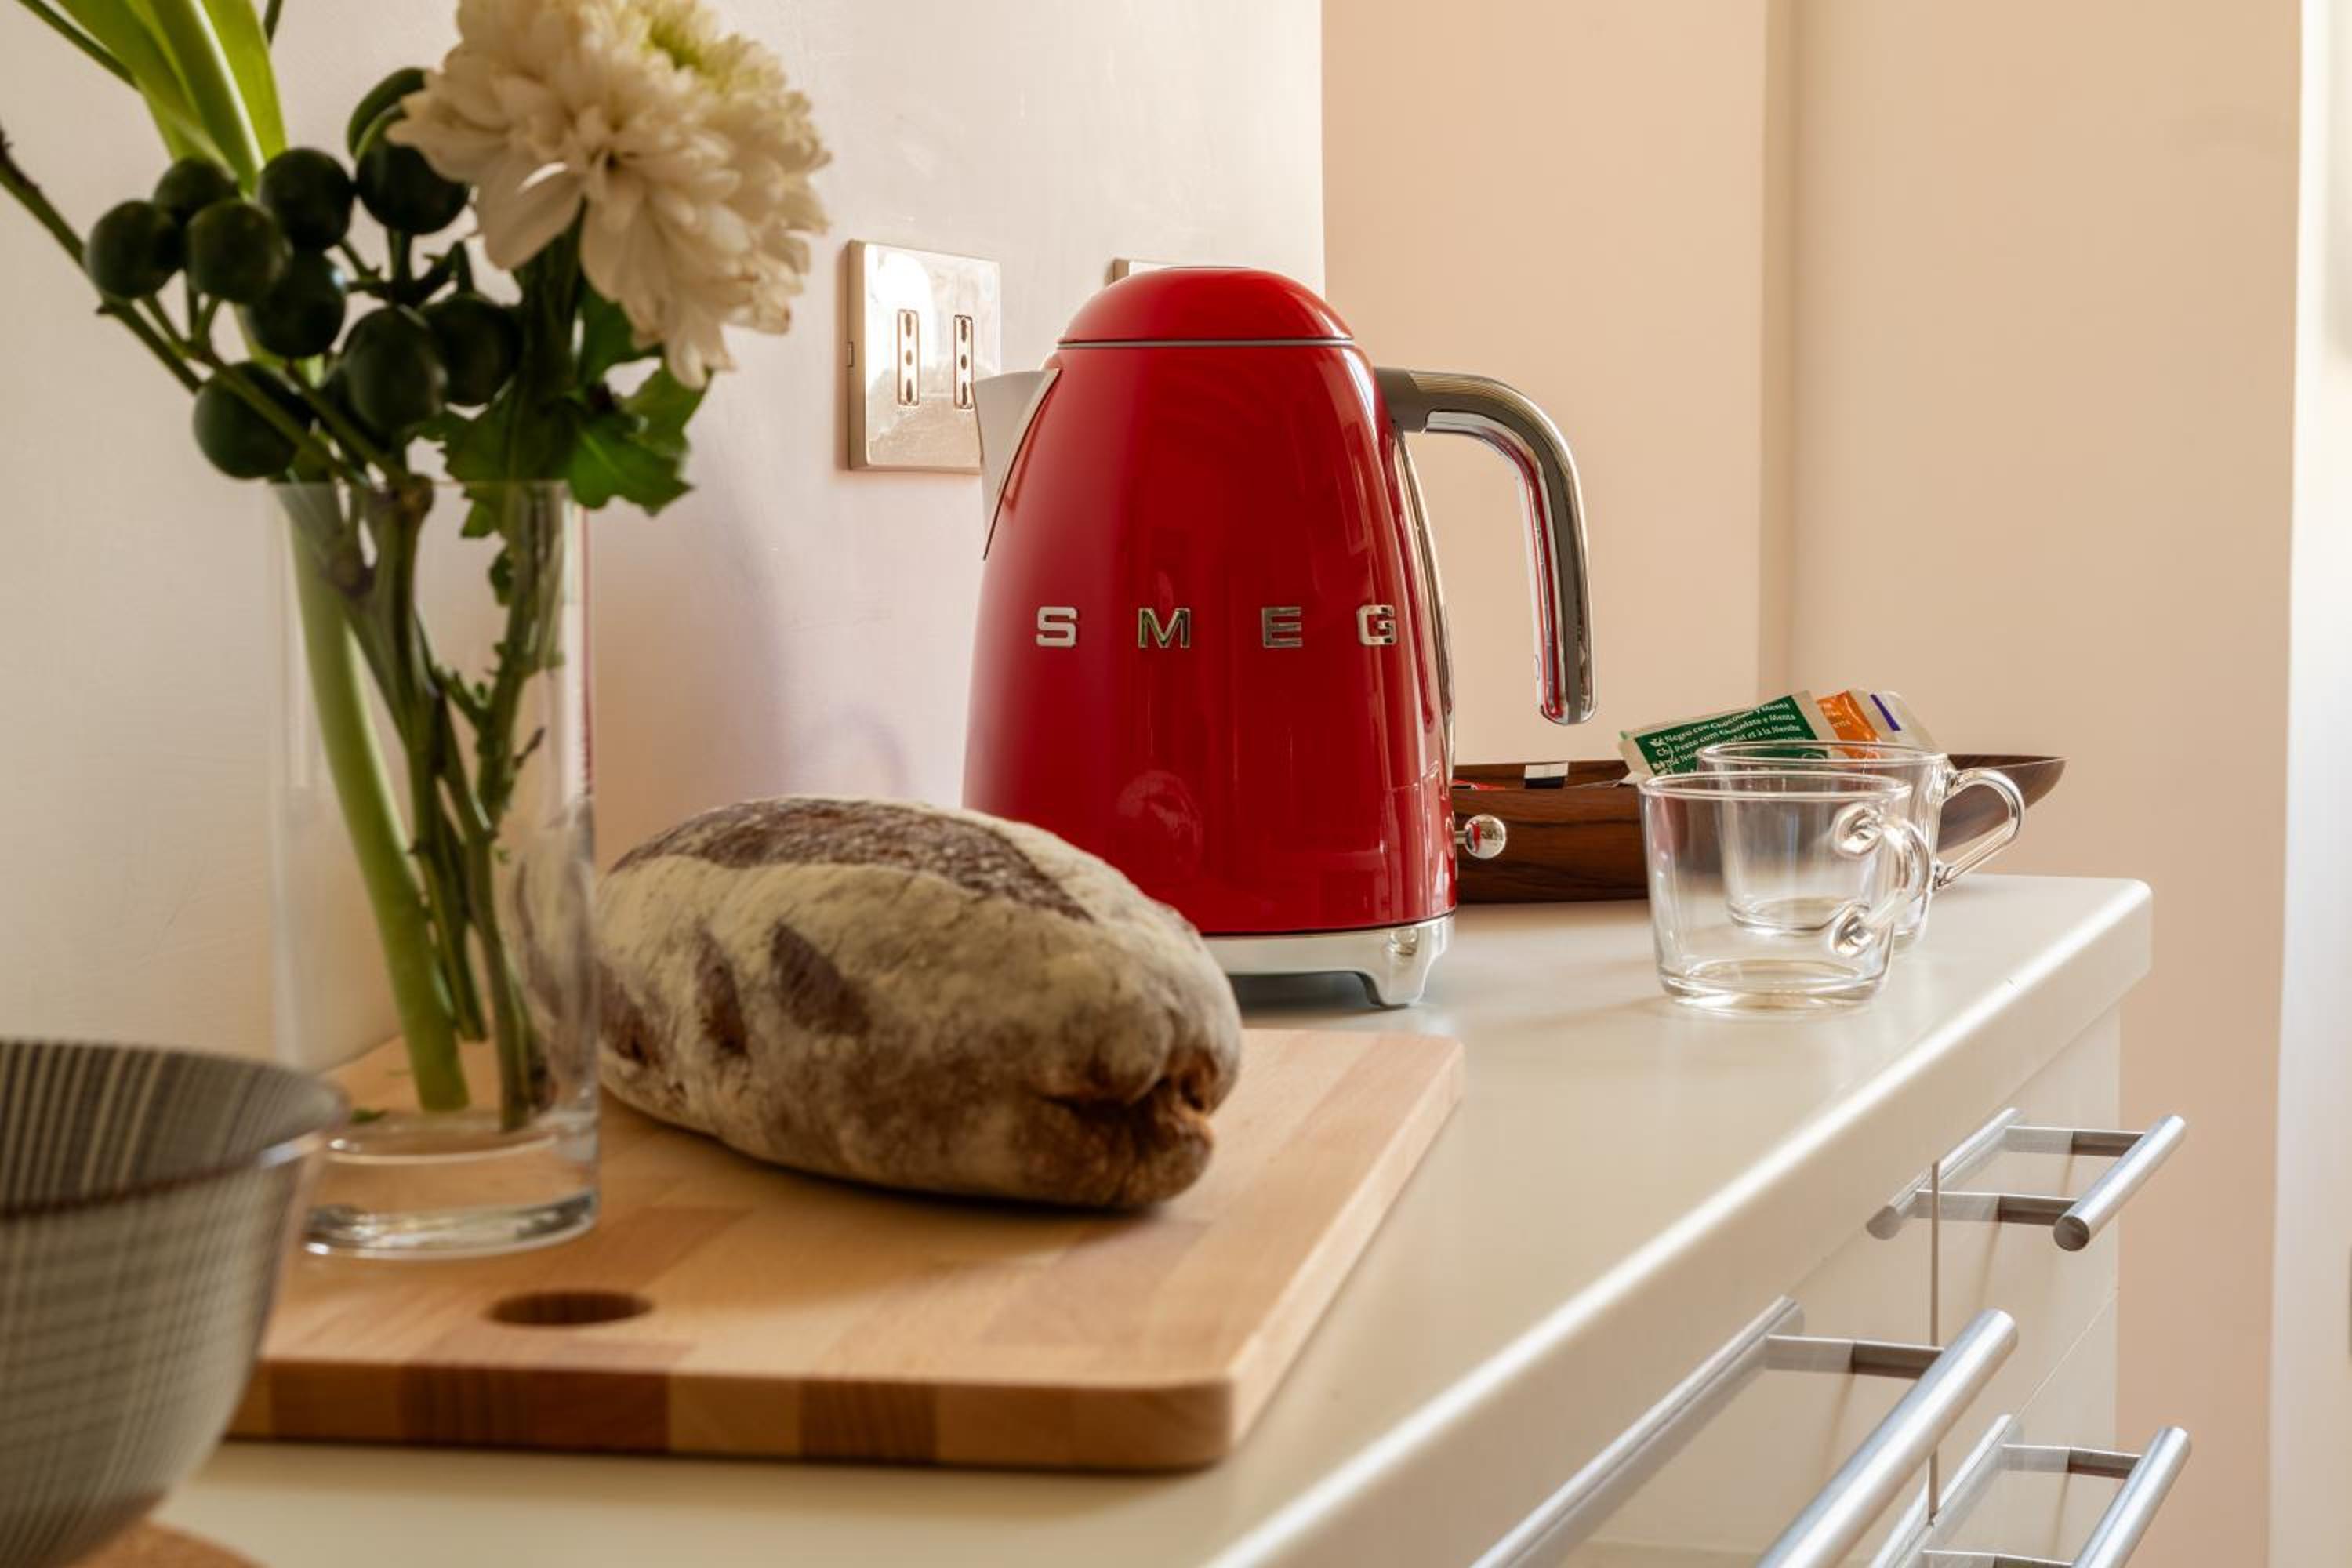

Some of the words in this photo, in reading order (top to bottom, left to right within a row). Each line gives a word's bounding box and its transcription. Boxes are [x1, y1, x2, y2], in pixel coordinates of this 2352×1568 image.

[1036, 604, 1399, 649] SMEG
[1664, 731, 1692, 743] Negro
[1693, 724, 1709, 734] con
[1761, 702, 1790, 711] Menta
[1674, 740, 1699, 752] Preto
[1700, 731, 1719, 742] com
[1769, 713, 1796, 722] Menta
